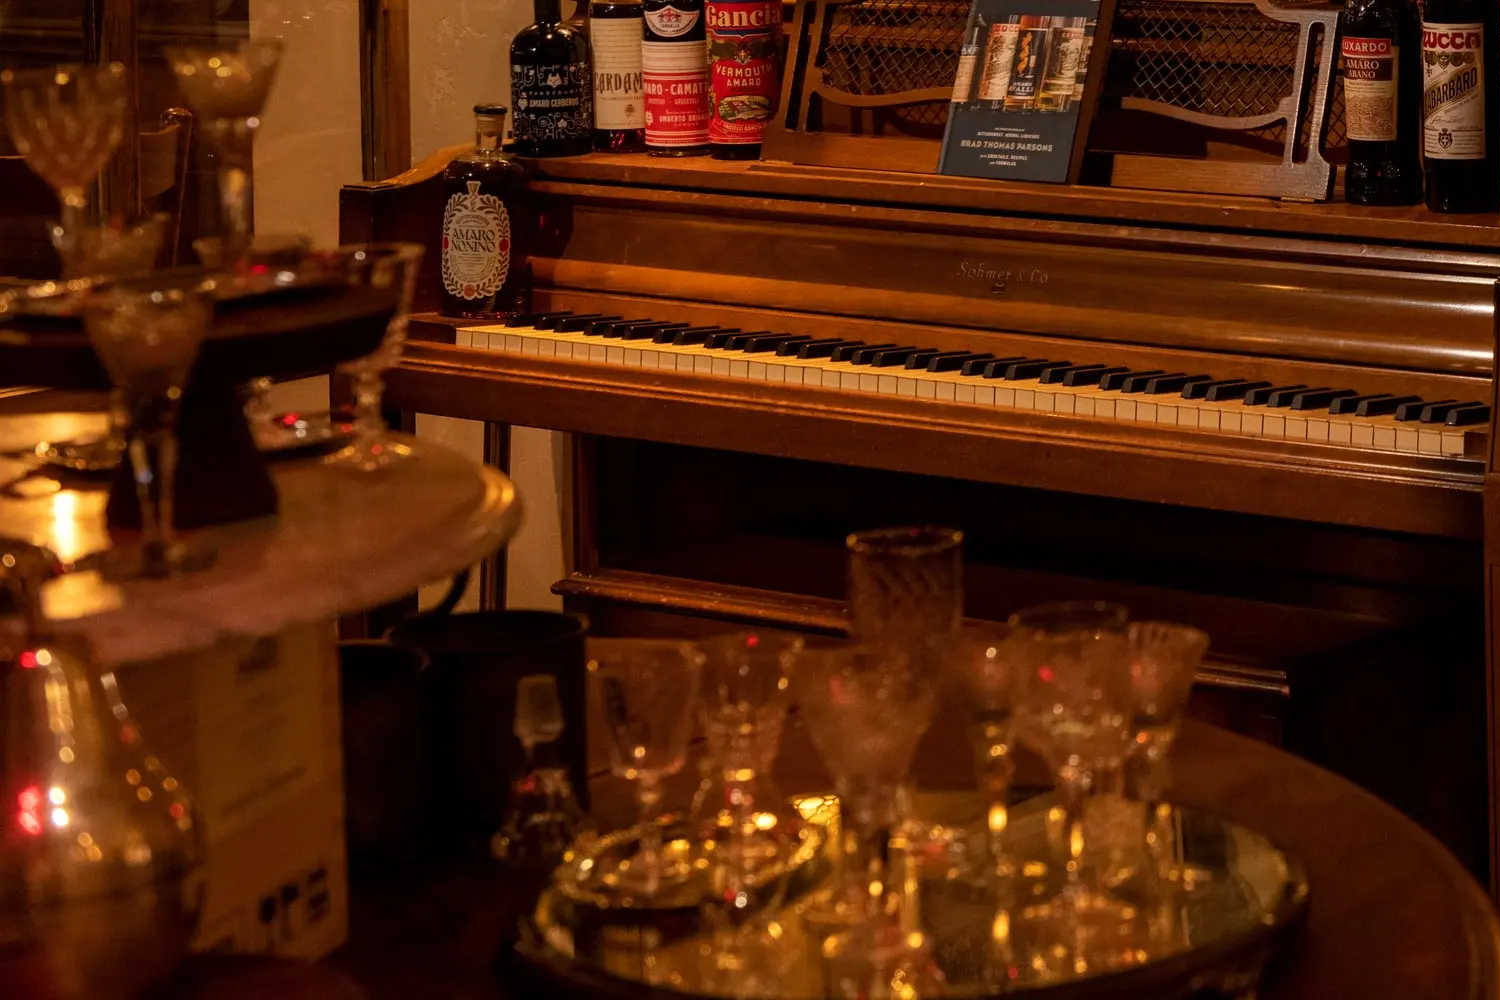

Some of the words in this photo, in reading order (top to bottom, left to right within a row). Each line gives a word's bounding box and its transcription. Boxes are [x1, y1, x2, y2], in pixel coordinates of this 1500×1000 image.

[706, 4, 780, 27] Gancia
[715, 63, 773, 77] VERMOUTH
[1346, 59, 1380, 70] AMARO
[1348, 69, 1376, 79] ABANO
[725, 77, 761, 87] AMARO
[529, 99, 550, 108] AMARO
[960, 140, 982, 148] BRAD
[983, 141, 1016, 150] THOMAS
[1017, 143, 1053, 152] PARSONS
[452, 228, 496, 241] AMARO
[451, 240, 496, 252] NONINO
[956, 261, 1012, 280] Sohmer
